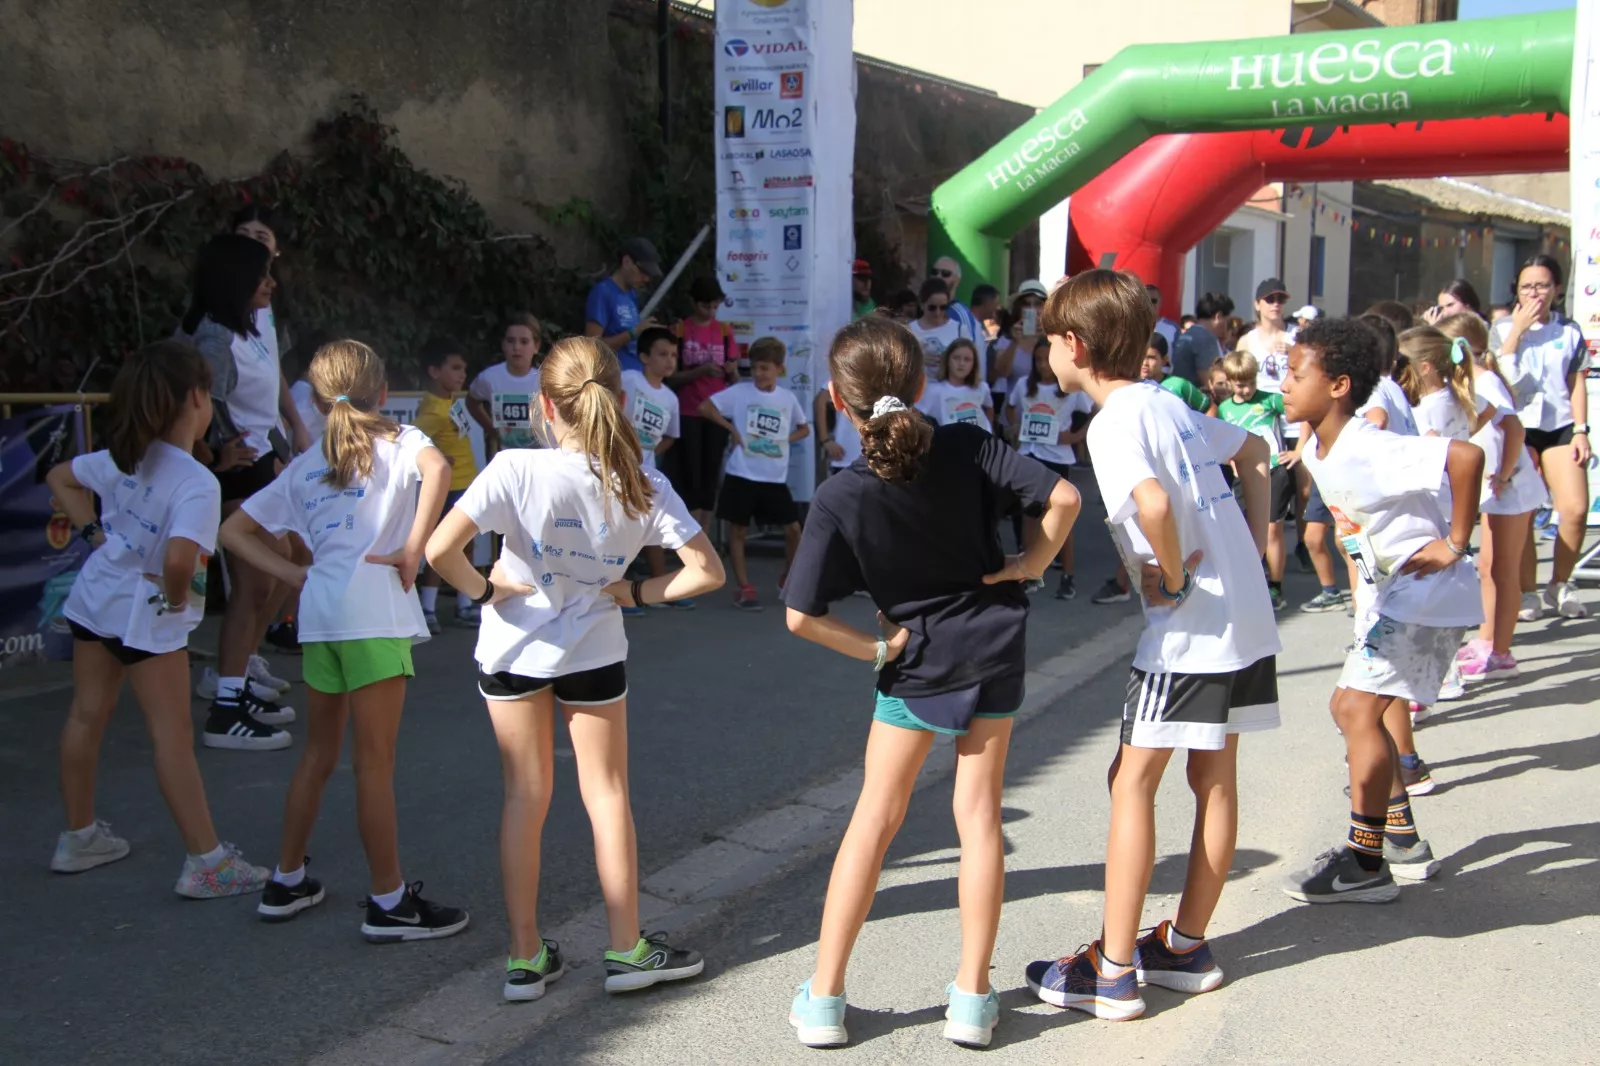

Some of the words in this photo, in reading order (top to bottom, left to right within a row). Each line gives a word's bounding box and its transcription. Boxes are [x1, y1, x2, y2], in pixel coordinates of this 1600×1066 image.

[752, 40, 808, 55] VIDAL
[741, 79, 774, 92] villar
[752, 107, 802, 129] Mo2
[769, 147, 812, 159] LASAOSA
[504, 404, 527, 418] 461
[643, 411, 663, 428] 472
[758, 415, 779, 431] 462
[1029, 422, 1050, 436] 464
[555, 520, 583, 529] QUICENA
[543, 544, 563, 556] Mo2
